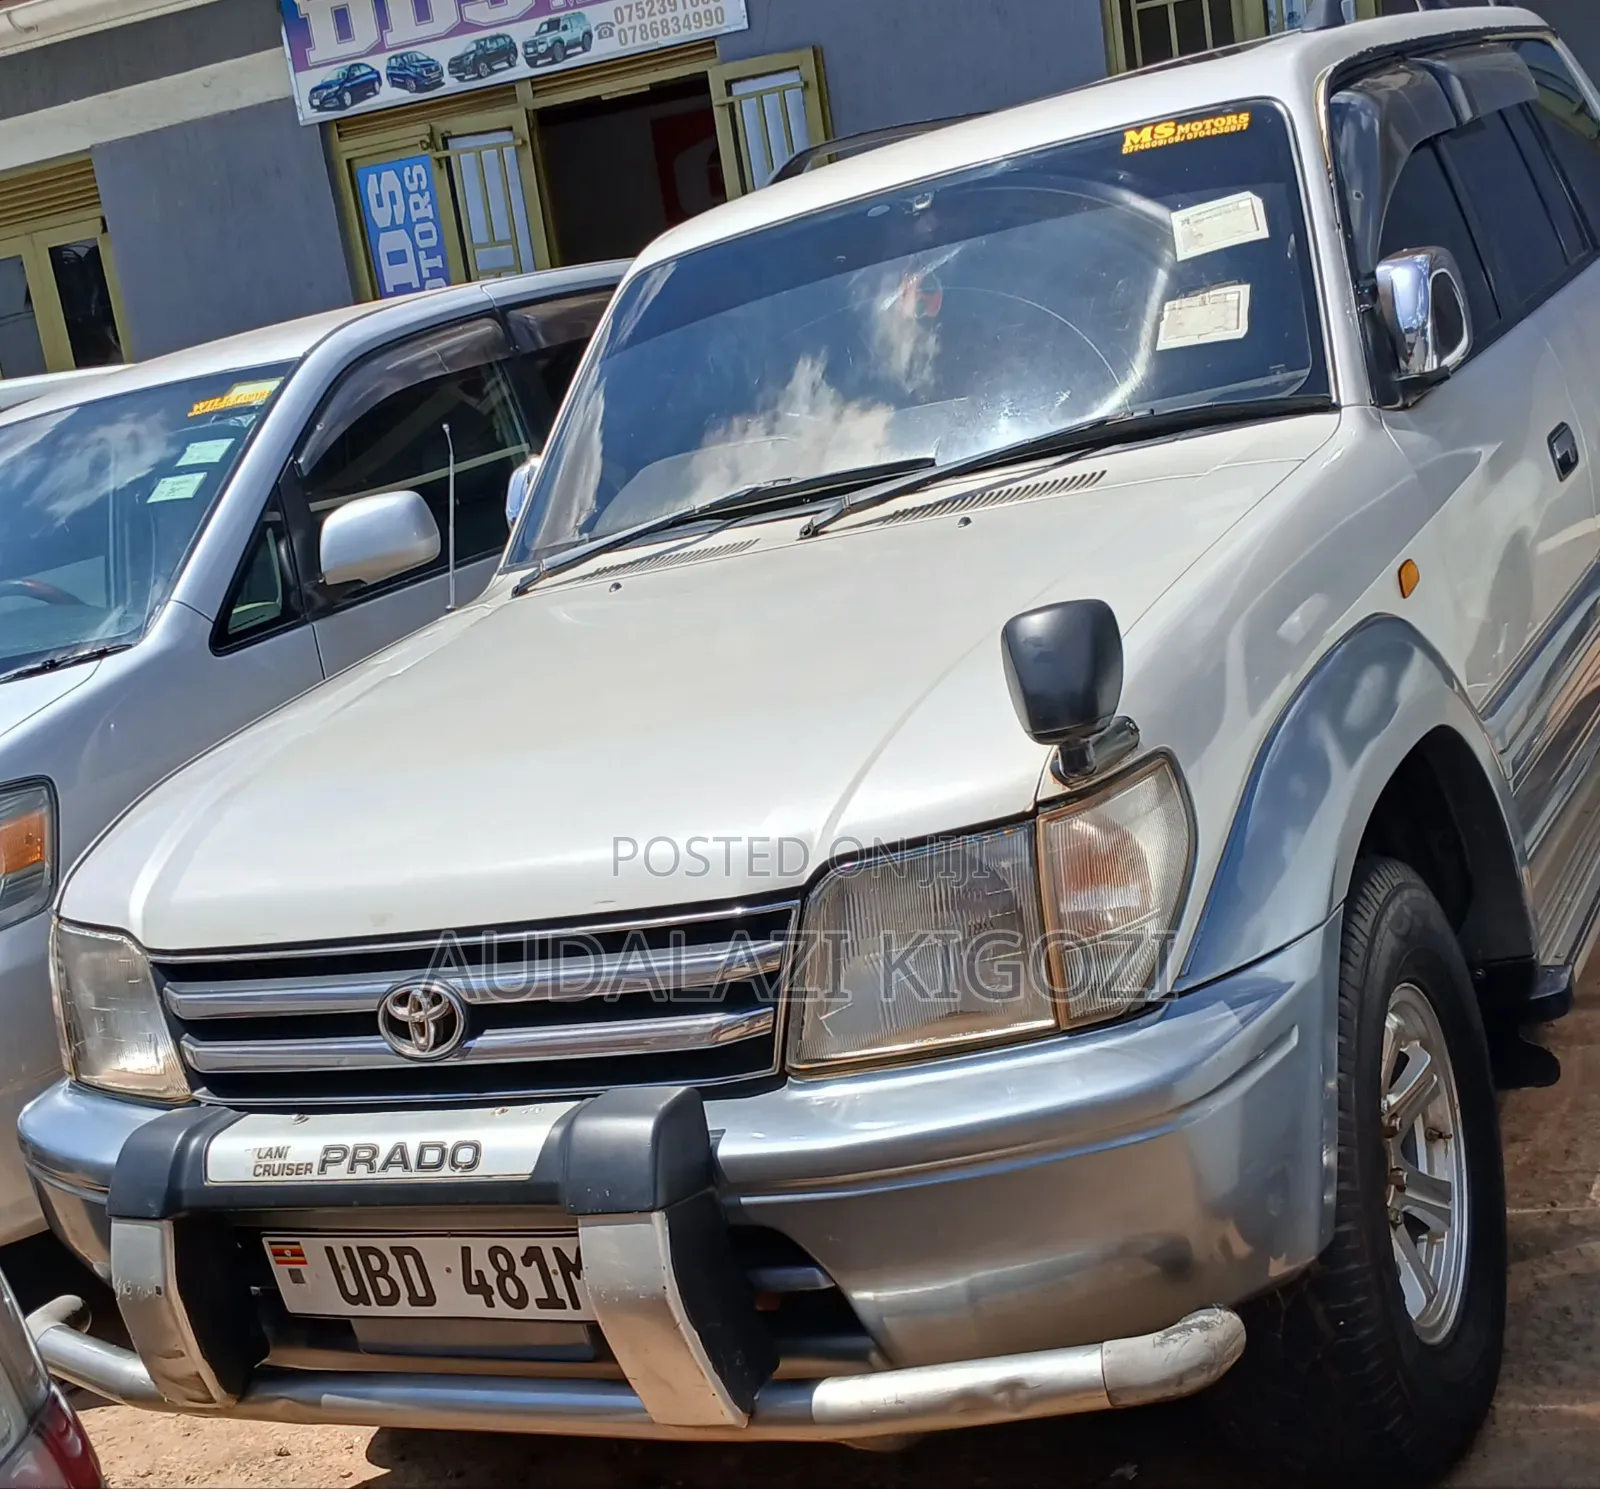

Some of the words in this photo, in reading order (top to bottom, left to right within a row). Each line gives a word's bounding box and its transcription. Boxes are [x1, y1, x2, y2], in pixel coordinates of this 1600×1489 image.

[618, 6, 725, 46] 0786834990
[1122, 121, 1176, 148] MS
[1176, 112, 1251, 135] MOTORS
[252, 1161, 314, 1178] CRUISER
[317, 1139, 482, 1176] PRADO
[323, 1245, 438, 1307] UBD
